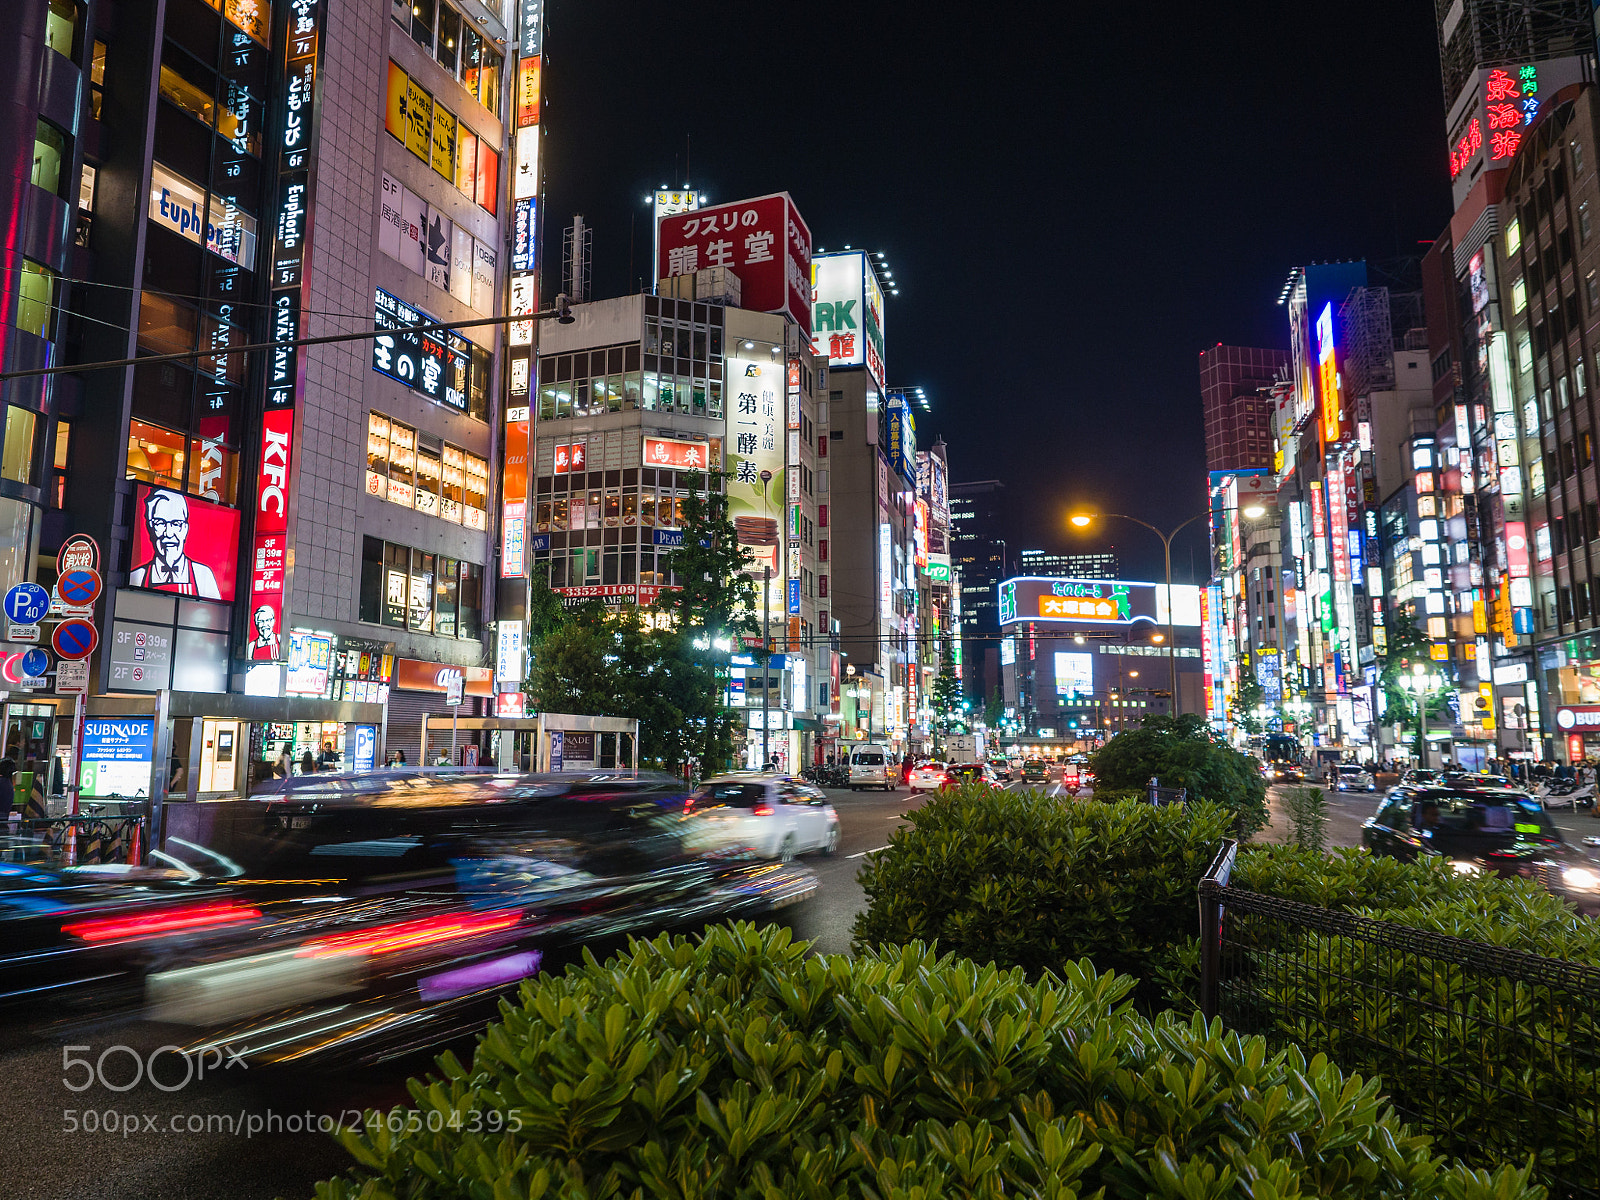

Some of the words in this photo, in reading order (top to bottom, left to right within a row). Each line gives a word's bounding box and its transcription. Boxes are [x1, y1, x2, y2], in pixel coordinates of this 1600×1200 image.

[296, 42, 310, 54] 7F
[285, 75, 302, 146] ともしび
[1486, 69, 1524, 161] 東海苑
[522, 115, 536, 126] 6F
[288, 155, 303, 167] 6F
[382, 180, 398, 197] 5F
[284, 184, 304, 249] Euphoria
[681, 209, 759, 240] クスリの
[515, 210, 528, 255] カラオケ
[667, 230, 775, 278] 龍生堂
[281, 270, 295, 284] 5F
[811, 299, 857, 333] RK
[422, 338, 455, 364] カラオケ
[274, 341, 287, 381] AVA
[374, 334, 442, 395] 王の宴
[272, 390, 287, 404] 4F
[445, 386, 466, 409] KING
[511, 408, 525, 420] 2F
[762, 389, 775, 451] 健康、美麗
[737, 391, 758, 484] 第一酵素
[507, 454, 527, 466] au
[261, 428, 290, 518] KFC
[265, 538, 275, 548] 3F
[533, 537, 544, 550] AR
[659, 530, 683, 545] PEAR
[65, 552, 91, 568] 消火栓
[262, 570, 274, 580] 2F
[565, 585, 636, 598] 3352-1109
[1052, 581, 1103, 598] たのめーる
[13, 592, 32, 618] P
[25, 606, 39, 618] 40
[1044, 599, 1113, 616] 大塚商会
[117, 631, 131, 644] 3F
[499, 633, 508, 678] SUNPARK
[114, 666, 128, 679] 2F
[85, 723, 149, 738] SUBNADE
[357, 734, 367, 756] P
[563, 735, 591, 746] NADE
[82, 768, 94, 789] 6
